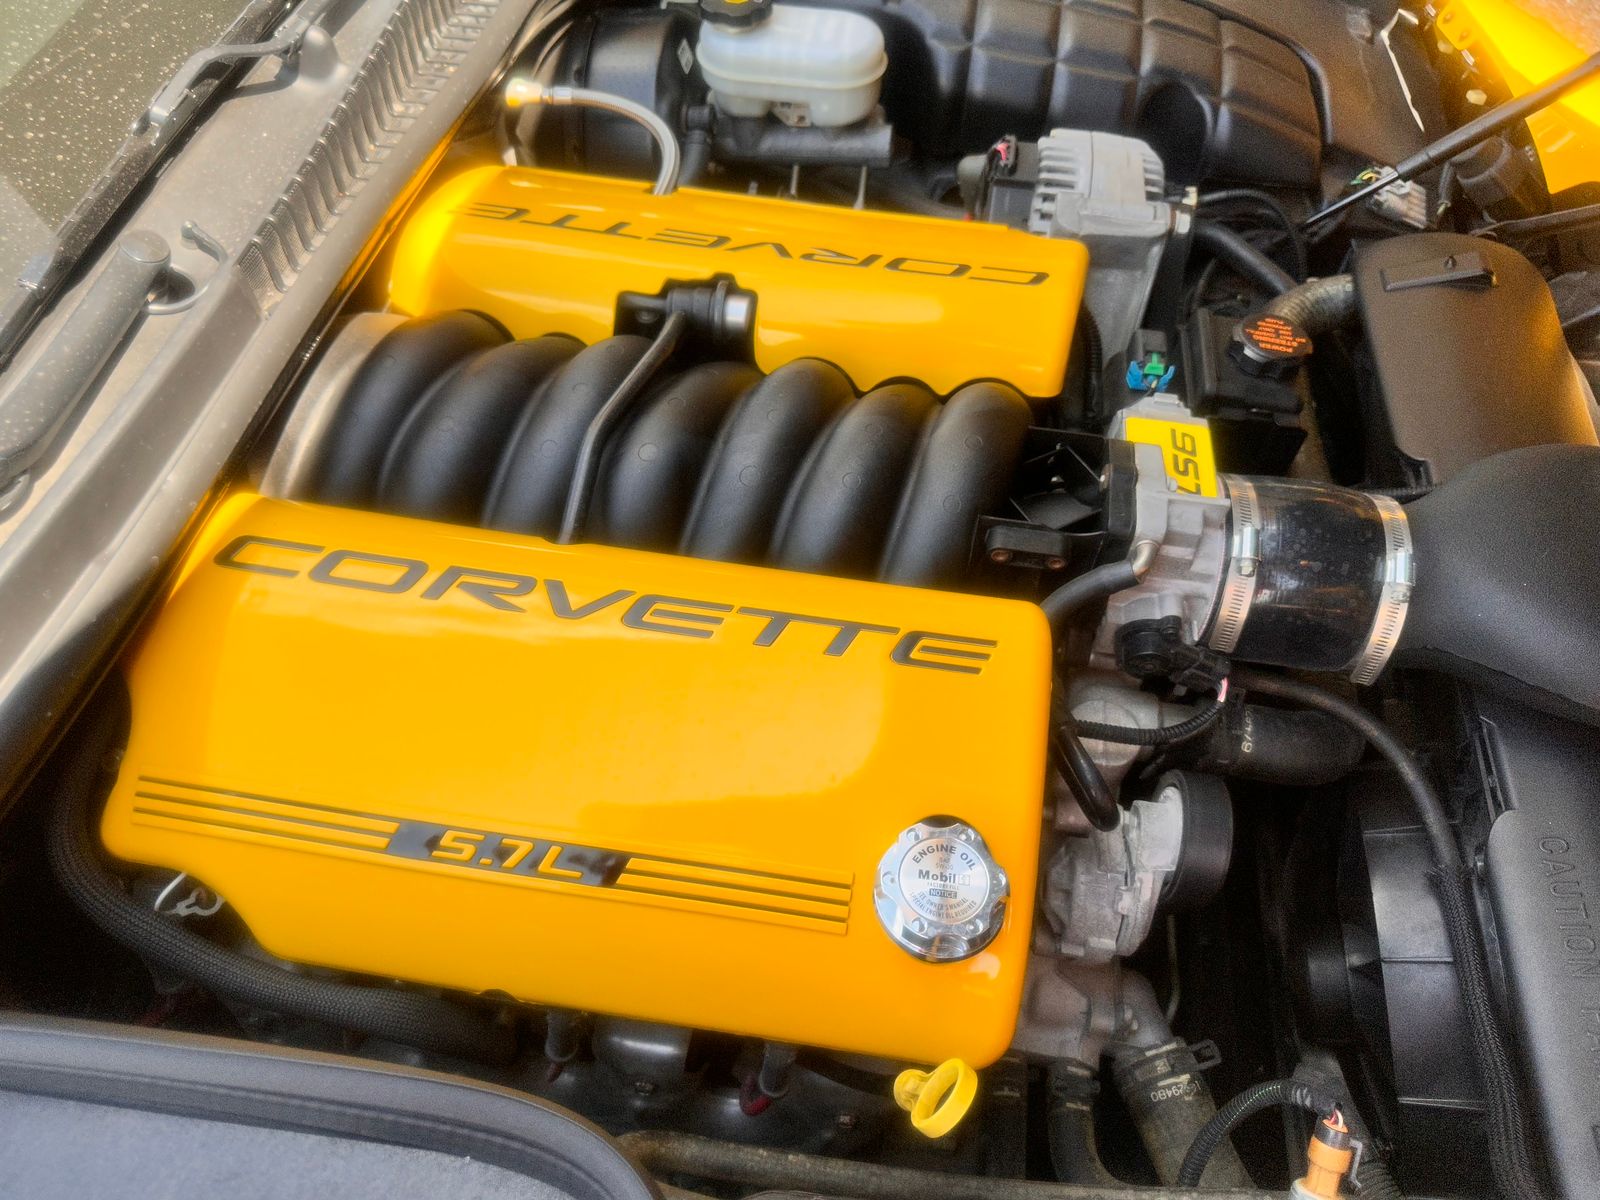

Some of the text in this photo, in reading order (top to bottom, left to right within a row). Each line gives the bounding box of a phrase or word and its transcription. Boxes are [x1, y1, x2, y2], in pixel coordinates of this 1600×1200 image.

[463, 202, 1049, 286] CORVETTE
[1258, 343, 1293, 353] POWER
[1170, 427, 1201, 496] LS6
[213, 534, 998, 675] CORVETTE
[431, 829, 583, 880] 5.7L
[912, 843, 976, 871] ENGINE OIL
[918, 869, 956, 884] Mobil
[929, 888, 958, 899] NOTICE
[1537, 835, 1599, 981] CAUTION
